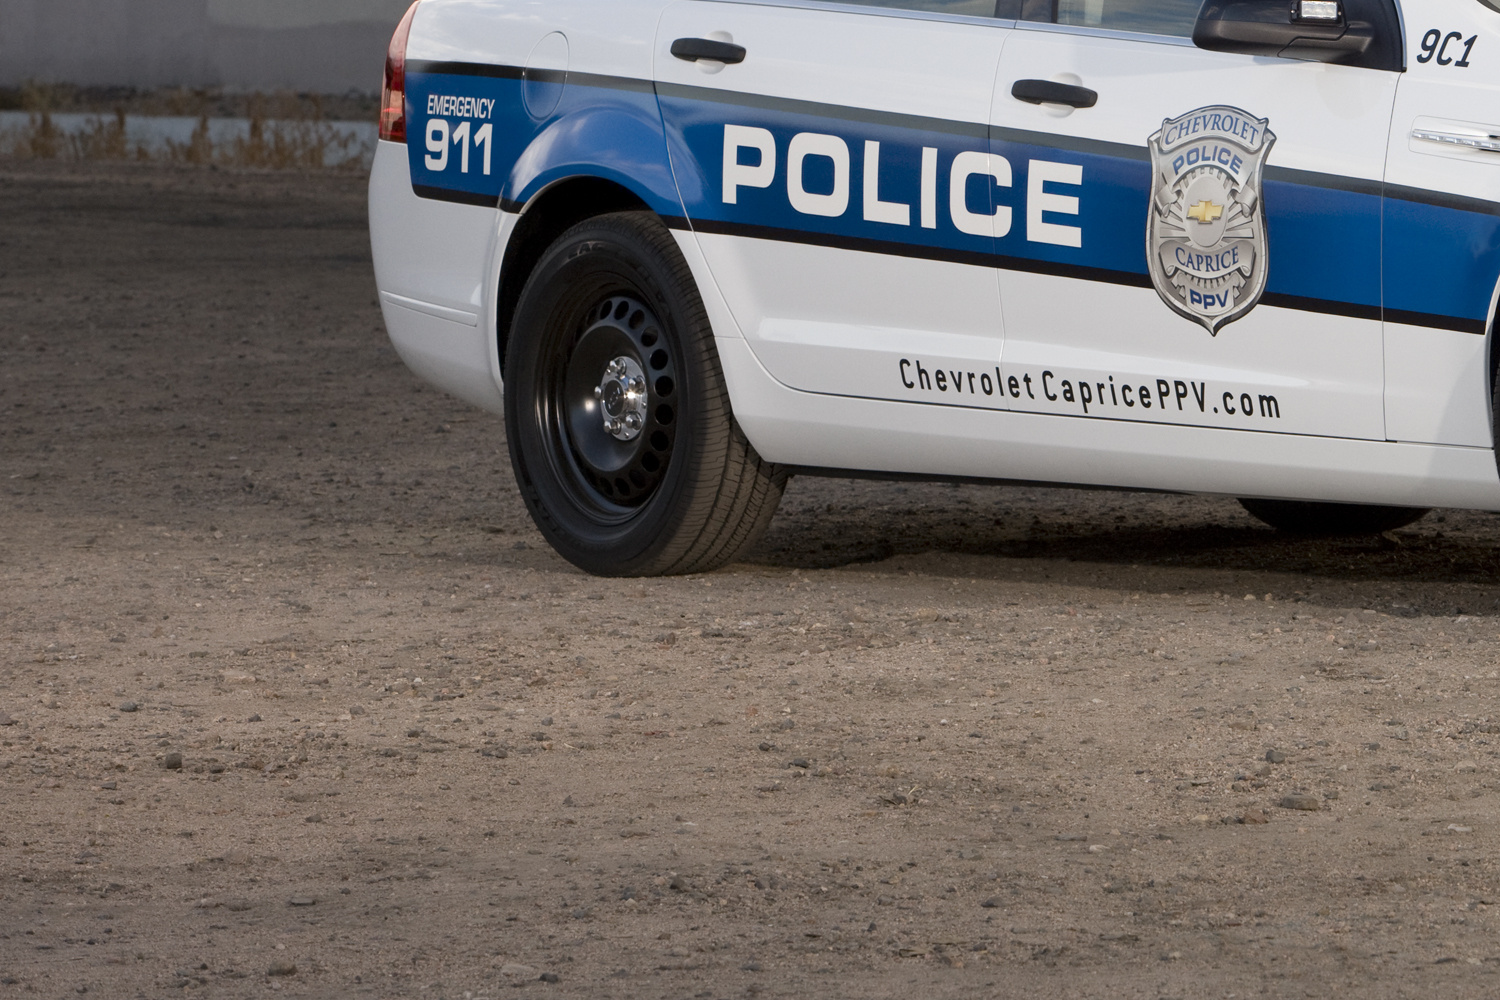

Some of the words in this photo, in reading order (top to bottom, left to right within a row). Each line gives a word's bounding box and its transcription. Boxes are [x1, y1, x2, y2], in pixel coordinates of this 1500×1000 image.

[1416, 28, 1478, 68] 9C1
[427, 94, 495, 119] EMERGENCY
[1164, 113, 1259, 146] CHEVROLET
[424, 118, 493, 176] 911
[1172, 145, 1243, 176] POLICE
[722, 123, 1083, 249] POLICE
[1175, 246, 1240, 272] CAPRICE
[1189, 288, 1229, 310] PPV
